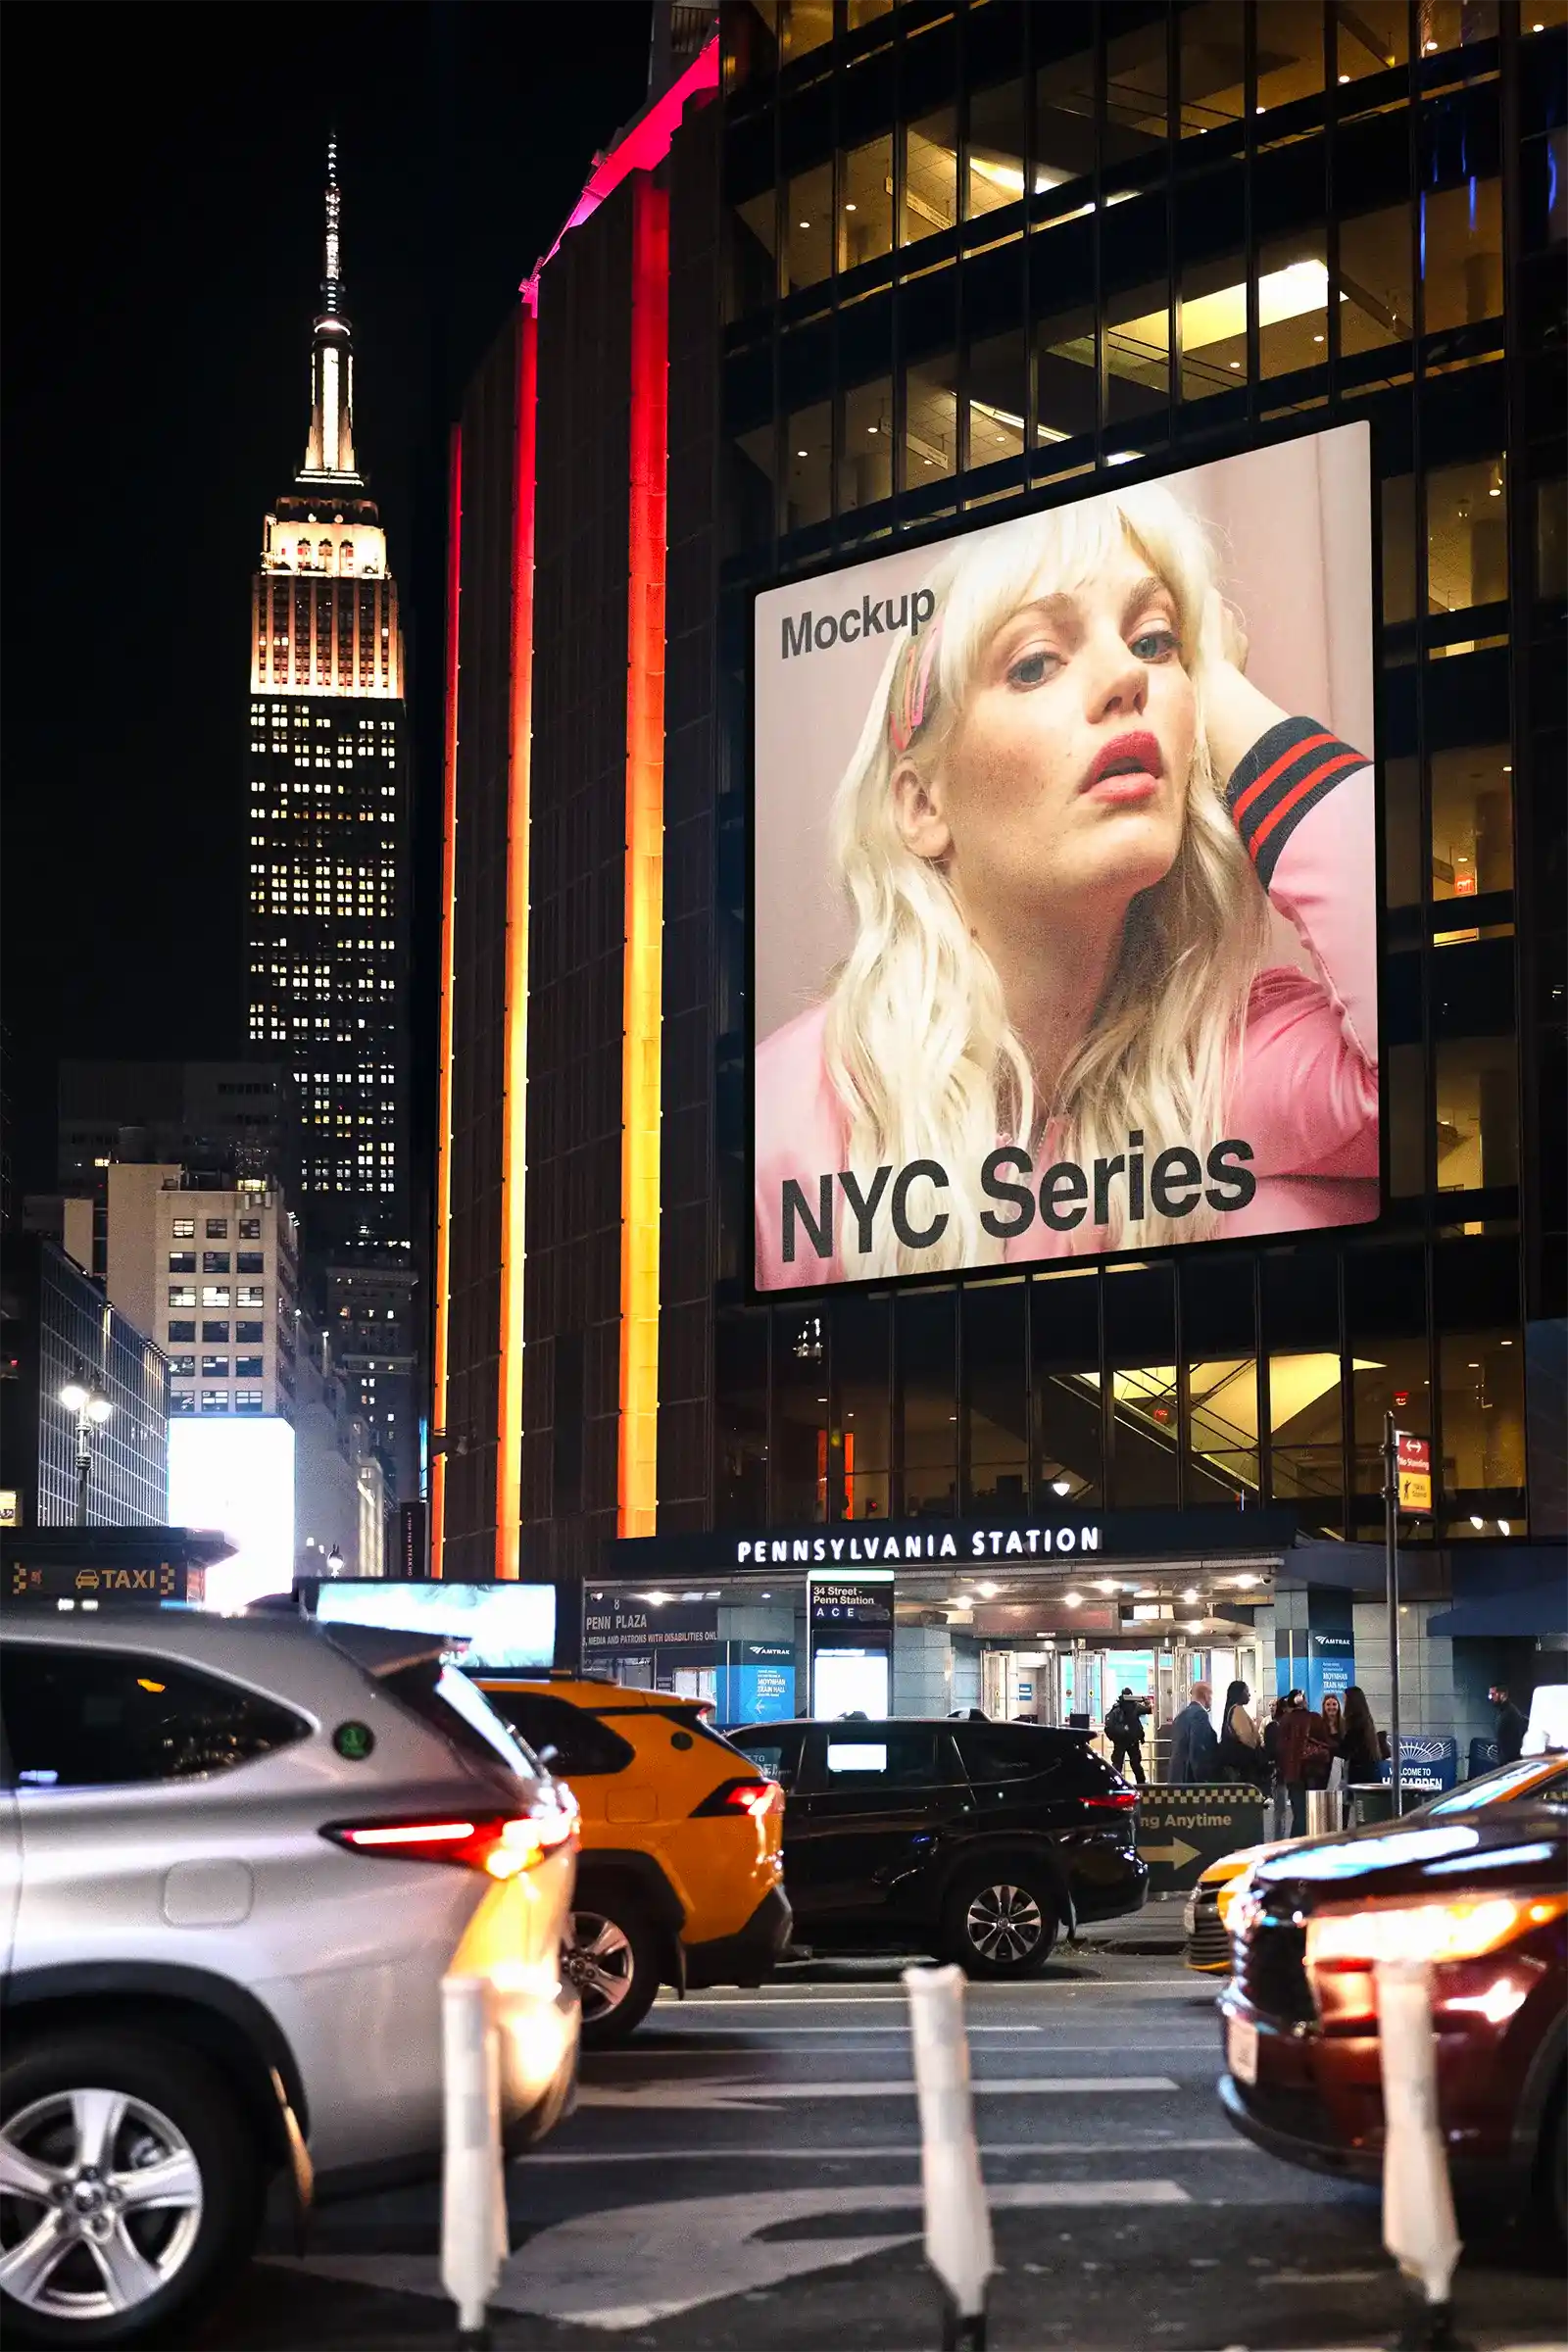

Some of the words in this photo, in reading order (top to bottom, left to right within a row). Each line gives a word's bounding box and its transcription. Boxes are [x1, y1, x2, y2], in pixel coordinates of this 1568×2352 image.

[782, 588, 935, 660] Mockup
[782, 1158, 949, 1262] NYC
[979, 1130, 1256, 1239] Series
[737, 1533, 956, 1564] PENNSYLVANIA
[971, 1526, 1100, 1556] STATION
[101, 1569, 156, 1589] TAXI
[813, 1587, 825, 1595] 34
[827, 1587, 858, 1595] Street
[812, 1595, 838, 1604] Penn
[839, 1595, 874, 1604] Station
[816, 1607, 825, 1617] A
[831, 1607, 840, 1617] C
[847, 1607, 855, 1617] E
[586, 1616, 612, 1630] PENN
[615, 1614, 647, 1629] PLAZA
[588, 1636, 607, 1645] MEDIA
[607, 1635, 619, 1644] AND
[619, 1634, 647, 1643] PATRONS
[647, 1633, 663, 1642] WITH
[663, 1631, 704, 1642] DISABILITIES
[1164, 1812, 1233, 1829] Anytime
